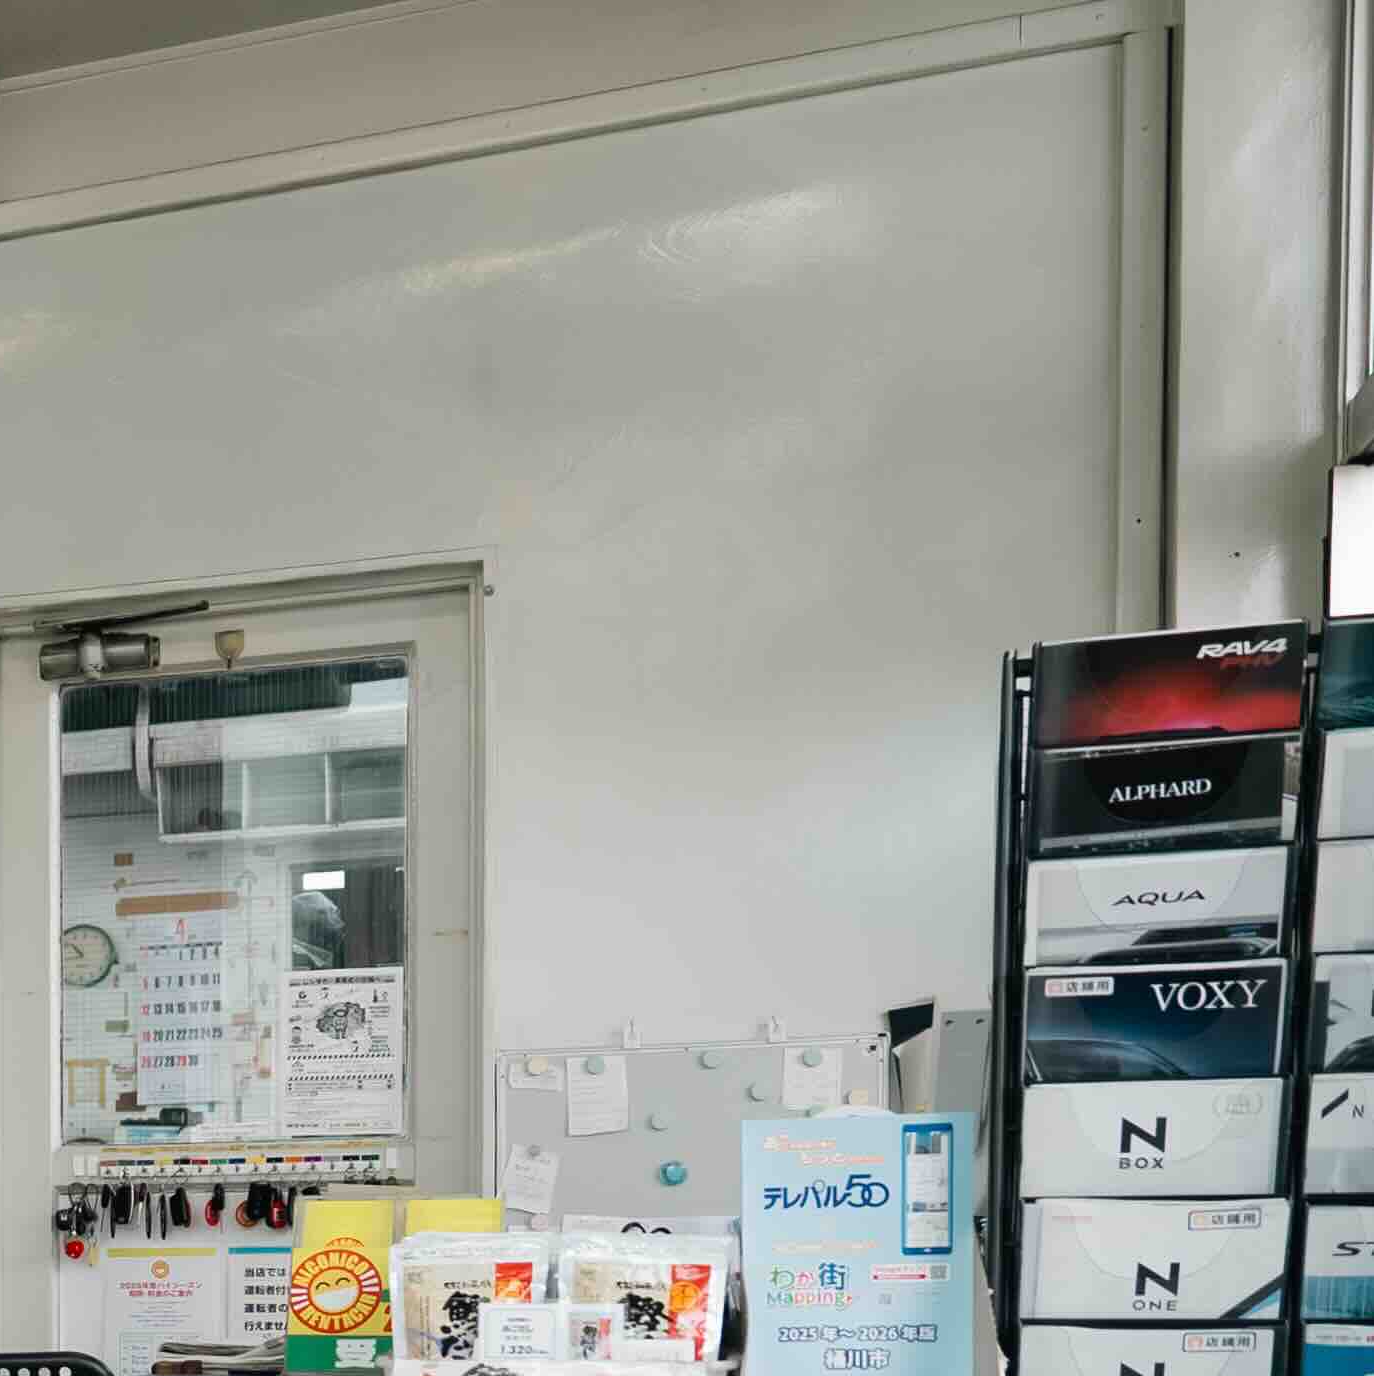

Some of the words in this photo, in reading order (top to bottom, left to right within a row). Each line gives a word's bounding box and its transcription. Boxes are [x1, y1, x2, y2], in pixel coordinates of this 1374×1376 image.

[1196, 636, 1289, 661] RAV4
[1108, 777, 1213, 804] ALPHARD
[1110, 887, 1206, 907] AQUA
[1149, 977, 1268, 1012] VOXY
[1120, 1115, 1169, 1154] N
[1118, 1156, 1165, 1170] BOX
[763, 1173, 891, 1211] テレパル50
[243, 1267, 287, 1278] 当店では
[293, 1250, 369, 1288] NICONICO
[1133, 1261, 1182, 1297] N
[243, 1303, 287, 1314] 運転者の
[1132, 1300, 1178, 1312] ONE
